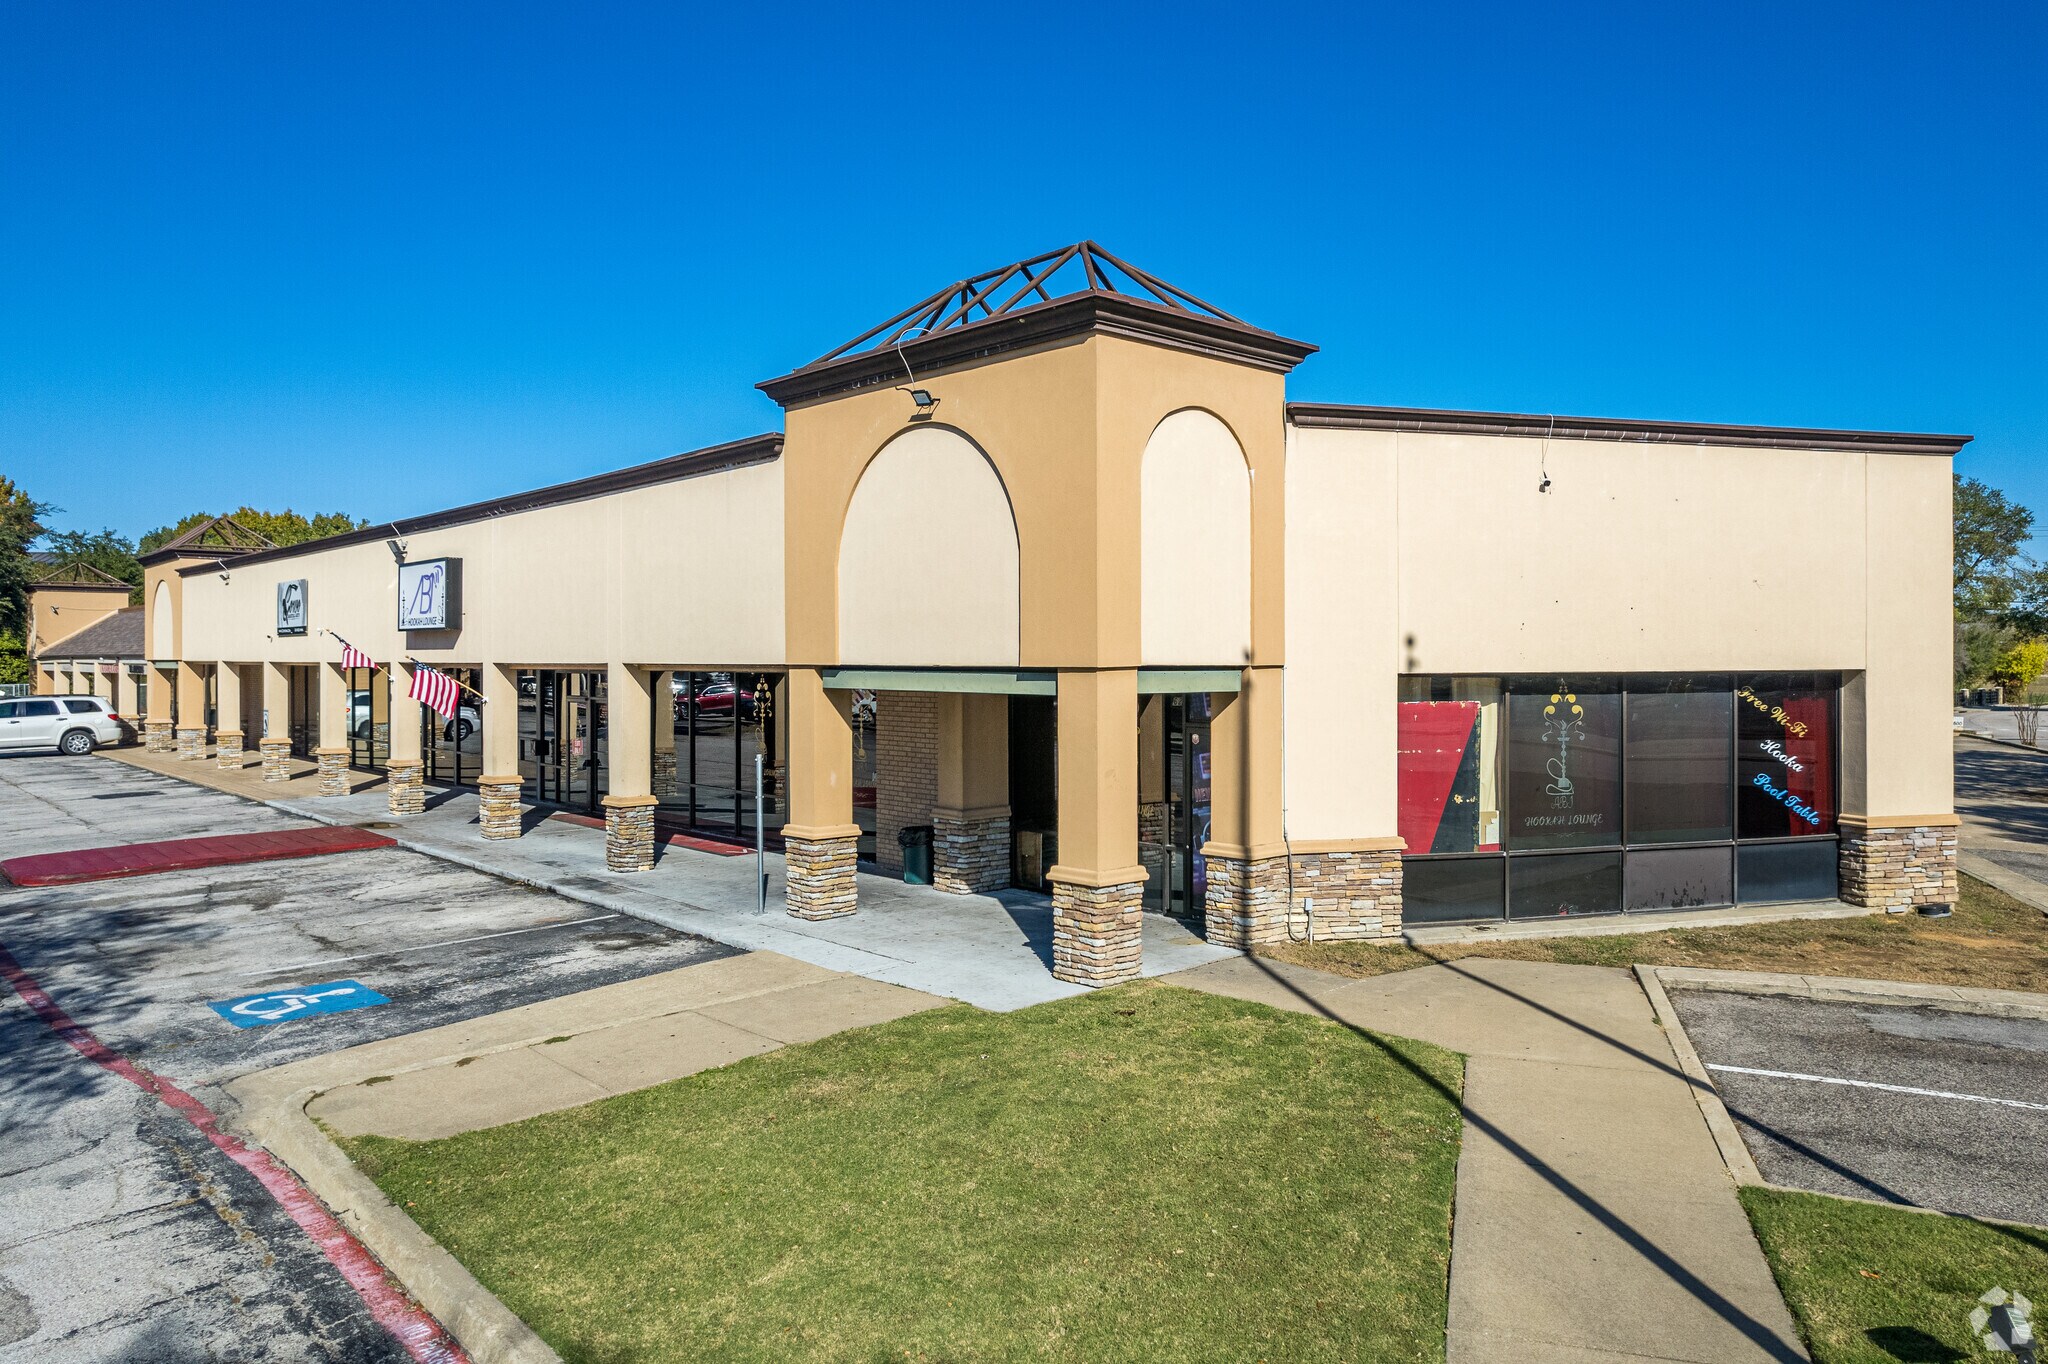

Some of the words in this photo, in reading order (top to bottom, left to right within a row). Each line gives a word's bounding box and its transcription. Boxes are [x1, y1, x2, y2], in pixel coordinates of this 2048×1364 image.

[408, 617, 422, 626] HOOKAH
[423, 616, 437, 625] LOUNGE
[1738, 686, 1768, 712] Free
[1771, 707, 1808, 737] Wi-Fi
[1760, 740, 1804, 772] Hooka
[1754, 773, 1788, 800] Pool
[1785, 796, 1820, 825] Table
[1525, 816, 1565, 827] HOOKAH
[1568, 814, 1604, 827] LOUNGE
